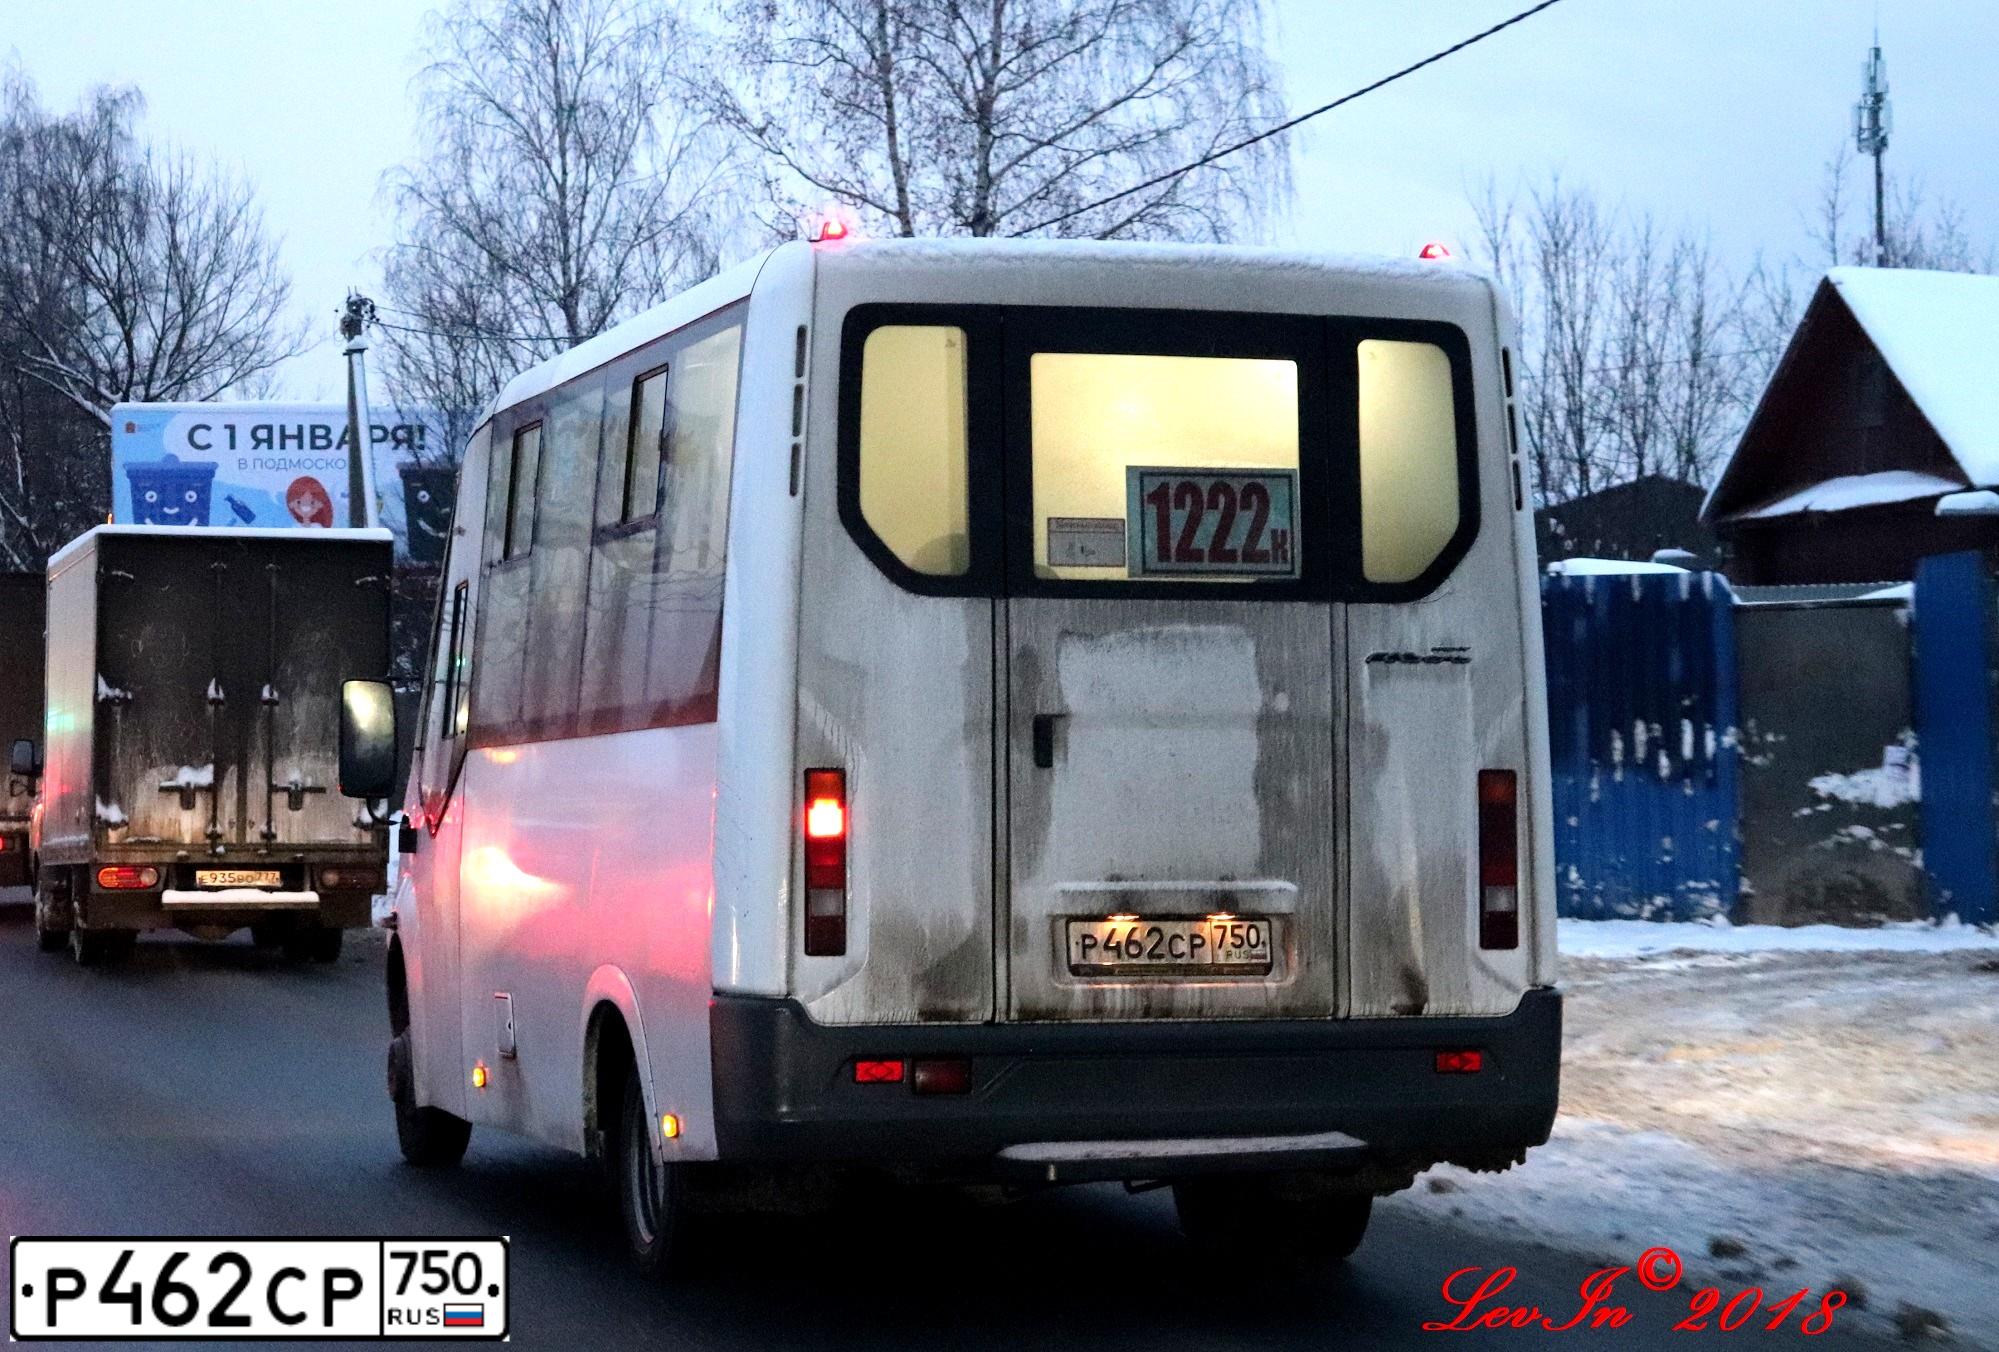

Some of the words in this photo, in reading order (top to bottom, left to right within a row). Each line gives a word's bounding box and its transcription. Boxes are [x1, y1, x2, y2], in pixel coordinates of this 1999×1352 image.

[187, 424, 214, 450] С
[223, 424, 236, 450] 1
[238, 458, 248, 470] В
[1081, 927, 1206, 960] Р462СР
[1213, 924, 1261, 949] 750
[1226, 951, 1249, 960] RUS
